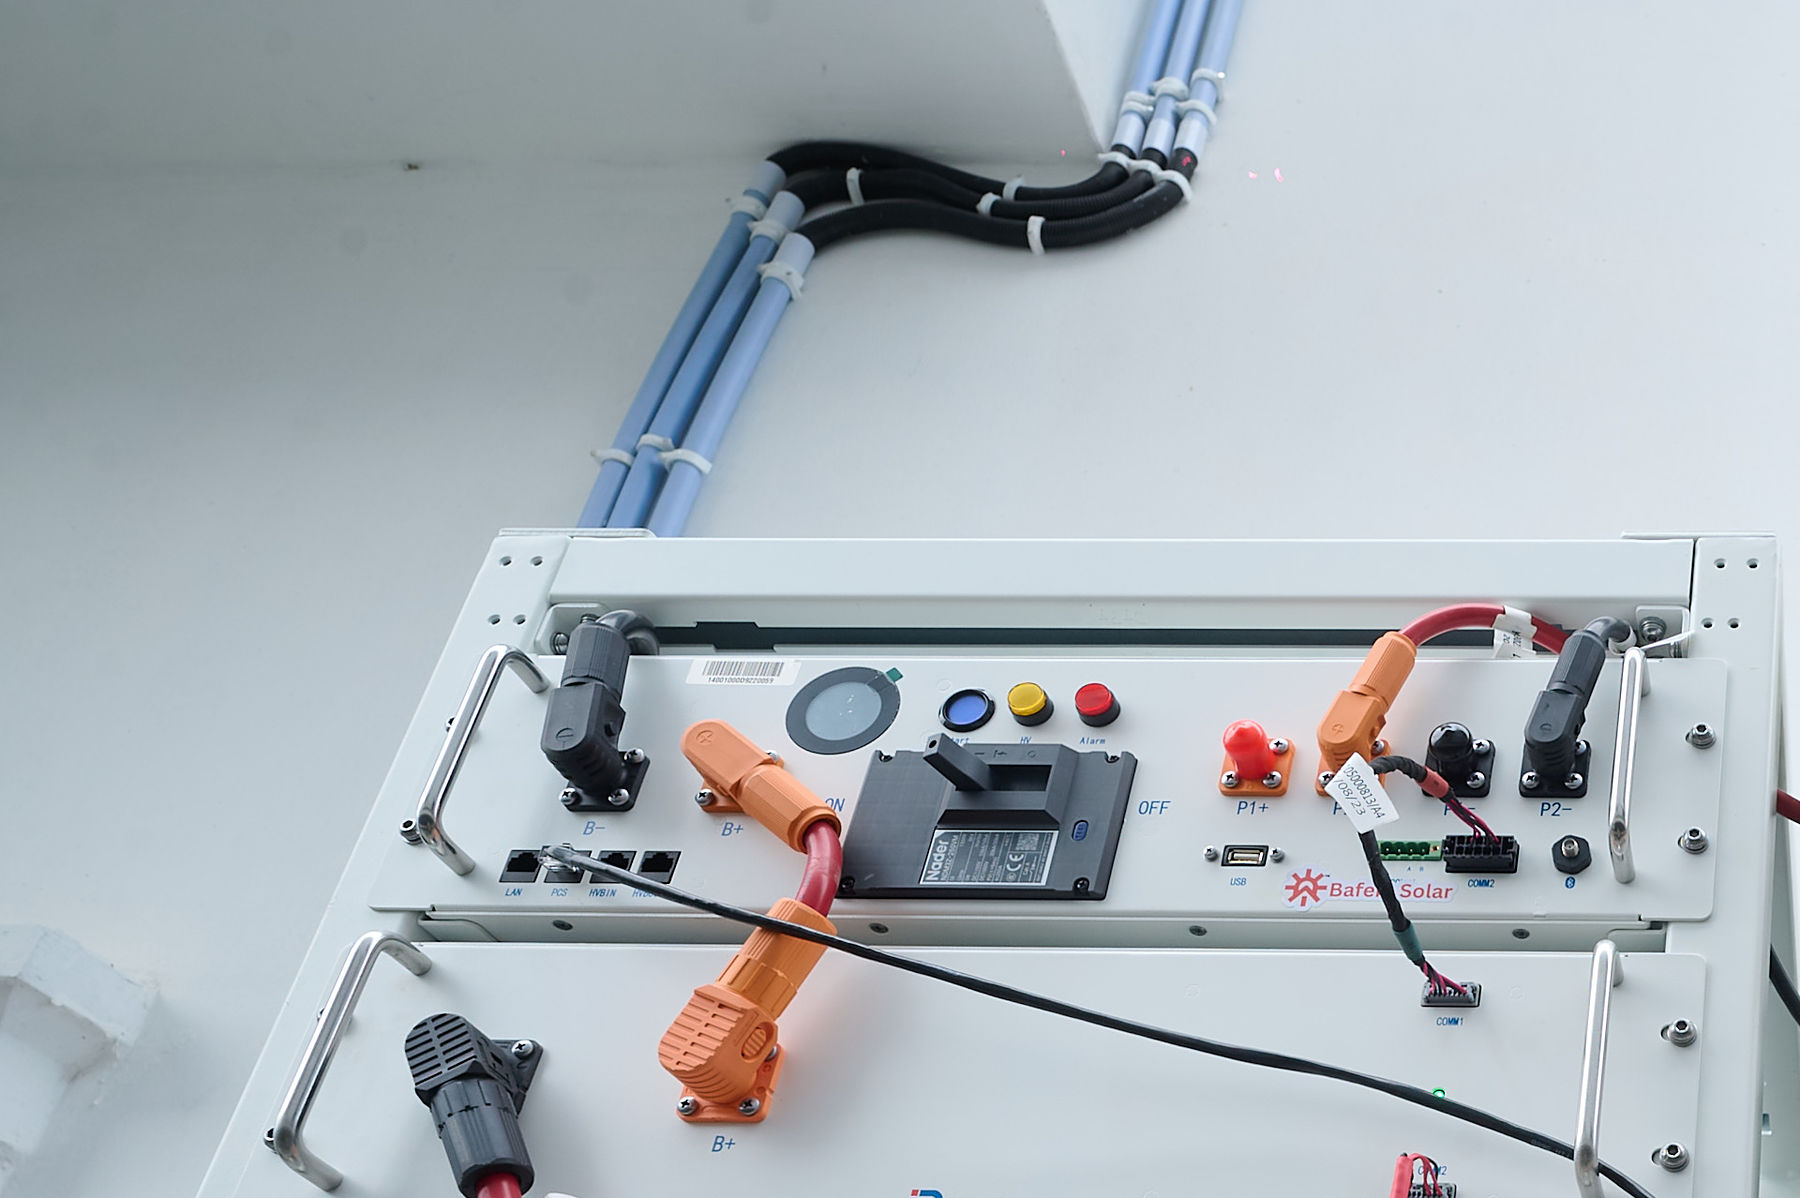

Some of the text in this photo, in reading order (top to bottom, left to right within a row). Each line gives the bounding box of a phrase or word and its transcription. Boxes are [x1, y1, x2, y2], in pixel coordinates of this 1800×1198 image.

[1079, 736, 1107, 745] Alarm
[1137, 799, 1171, 816] OFF
[1236, 799, 1270, 816] P1+
[1539, 800, 1573, 817] P2-
[582, 820, 606, 837] B-
[720, 821, 745, 838] B+
[925, 839, 950, 881] Nader
[1229, 876, 1248, 888] USB
[1468, 878, 1495, 889] COMM2
[505, 887, 523, 897] LAN
[551, 887, 569, 897] PCS
[589, 887, 618, 898] HVBIN
[1400, 883, 1454, 900] Solar
[1435, 1016, 1464, 1027] COMM1
[711, 1135, 736, 1153] B+
